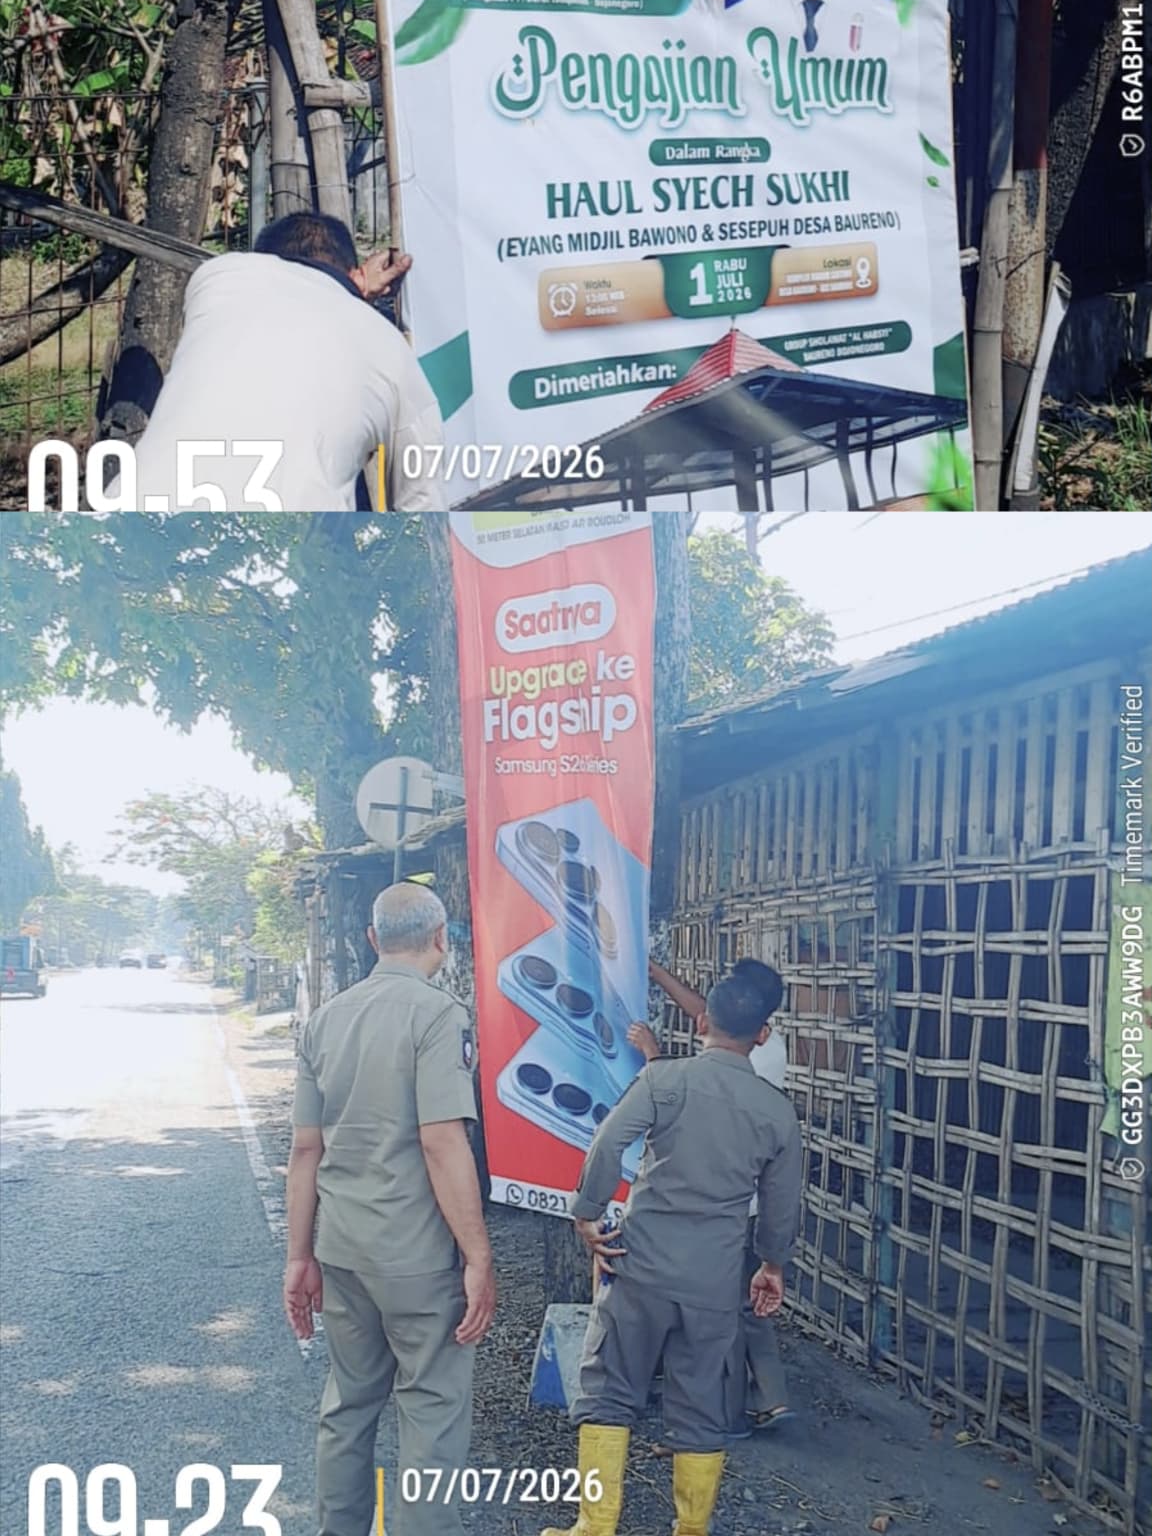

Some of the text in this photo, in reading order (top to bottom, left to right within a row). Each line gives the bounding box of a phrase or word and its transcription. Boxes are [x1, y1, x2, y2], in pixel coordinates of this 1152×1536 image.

[494, 25, 891, 124] Pengajian Umum
[666, 143, 762, 163] Dalam Rangka
[546, 170, 850, 220] HAUL SYECH SUKHI
[497, 212, 902, 263] (EYANG MIDJIL BAWONO & SESEPUH DESA BAURENO)
[713, 258, 748, 273] RABU
[689, 261, 713, 306] 1
[717, 273, 744, 289] JULI
[717, 287, 752, 302] 2026
[533, 361, 678, 401] Dimeriahkan:
[597, 650, 636, 681] ke
[495, 756, 557, 777] Samsung
[527, 1189, 568, 1213] 0821
